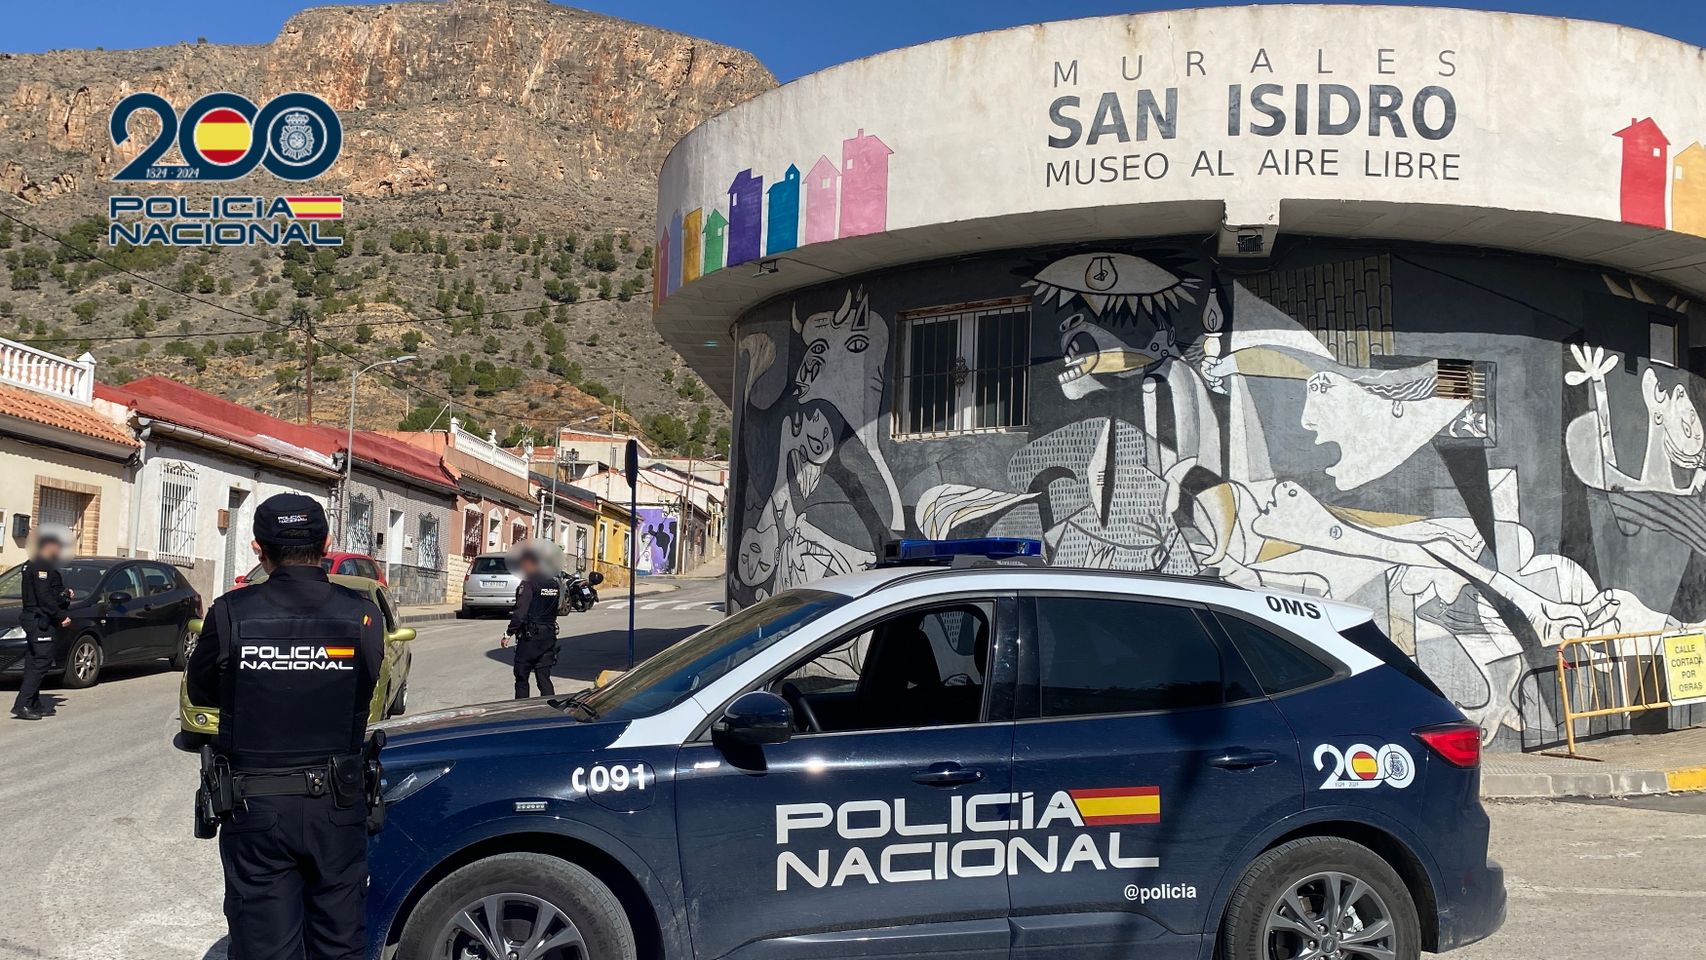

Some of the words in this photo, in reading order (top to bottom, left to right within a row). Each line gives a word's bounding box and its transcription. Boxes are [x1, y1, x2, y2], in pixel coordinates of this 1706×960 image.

[1053, 48, 1457, 88] MURALES
[1048, 87, 1178, 149] SAN
[1227, 83, 1457, 141] ISIDRO
[1046, 152, 1170, 188] MUSEO
[1191, 150, 1235, 177] AL
[1258, 149, 1340, 176] AIRE
[1364, 150, 1460, 181] LIBRE
[1265, 595, 1322, 620] OMS
[1675, 644, 1696, 654] CALLE
[240, 660, 353, 670] NACIONAL
[1671, 656, 1703, 668] CORTADA
[1681, 670, 1696, 679] POR
[1679, 682, 1703, 692] OBRAS
[589, 763, 646, 792] 091
[1313, 744, 1415, 789] 200
[776, 832, 1160, 891] NACIONAL
[1123, 883, 1197, 904] @policia
